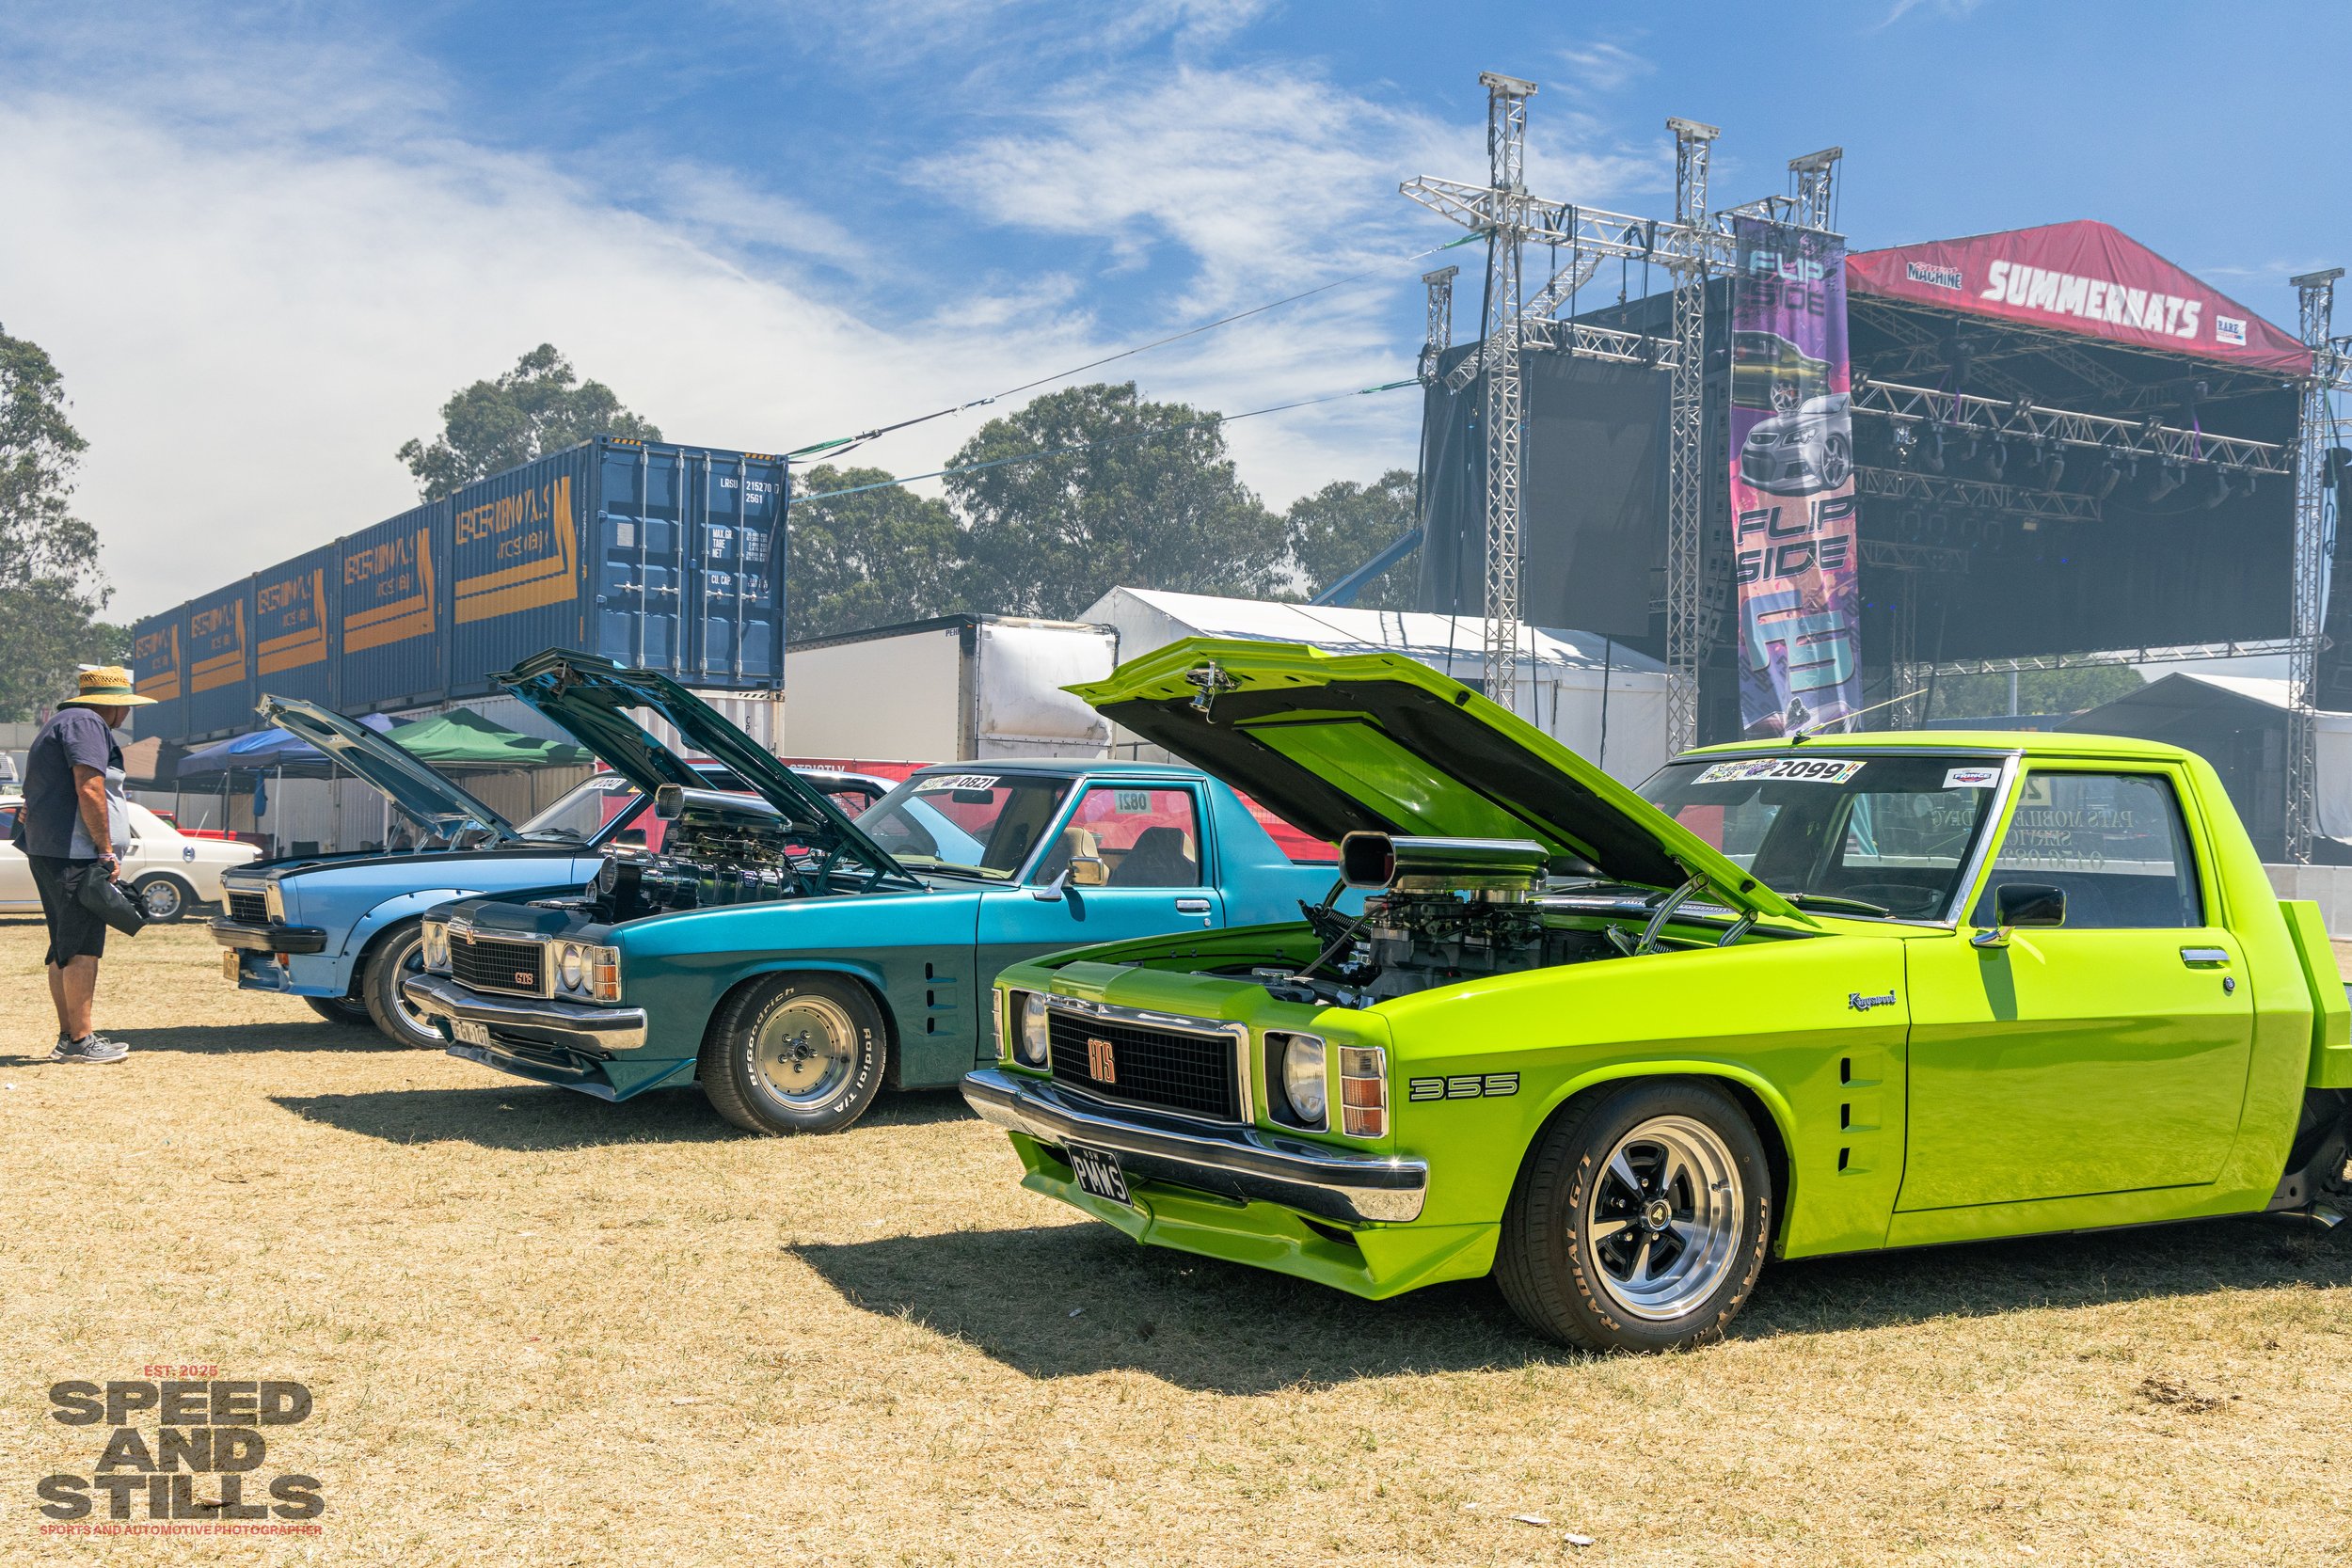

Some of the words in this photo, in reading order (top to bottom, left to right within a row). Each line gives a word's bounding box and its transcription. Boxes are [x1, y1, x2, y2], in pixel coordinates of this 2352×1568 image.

[1750, 250, 1824, 284] FLIP
[1908, 262, 1962, 290] MACHINE
[1750, 282, 1825, 317] SIDE
[1979, 259, 2203, 340] SUMMERNATS
[2217, 320, 2239, 334] RARE
[720, 478, 739, 489] LRSU
[746, 481, 771, 492] 215270
[1737, 494, 1856, 546] FLIP
[711, 548, 723, 559] NET
[1737, 533, 1851, 586] SIDE
[957, 776, 995, 789] 0821
[1770, 760, 1846, 779] 2099
[515, 972, 533, 985] GTS
[1848, 989, 1897, 1010] Kingswood
[746, 987, 795, 1086] BFGoodrich
[856, 1027, 873, 1089] Radial
[1088, 1037, 1116, 1084] GTS
[834, 1091, 858, 1114] T/A
[1409, 1071, 1520, 1102] 355
[1073, 1154, 1127, 1200] PMWS
[1569, 1148, 1591, 1209] G/T
[1566, 1222, 1621, 1332] RADIAL
